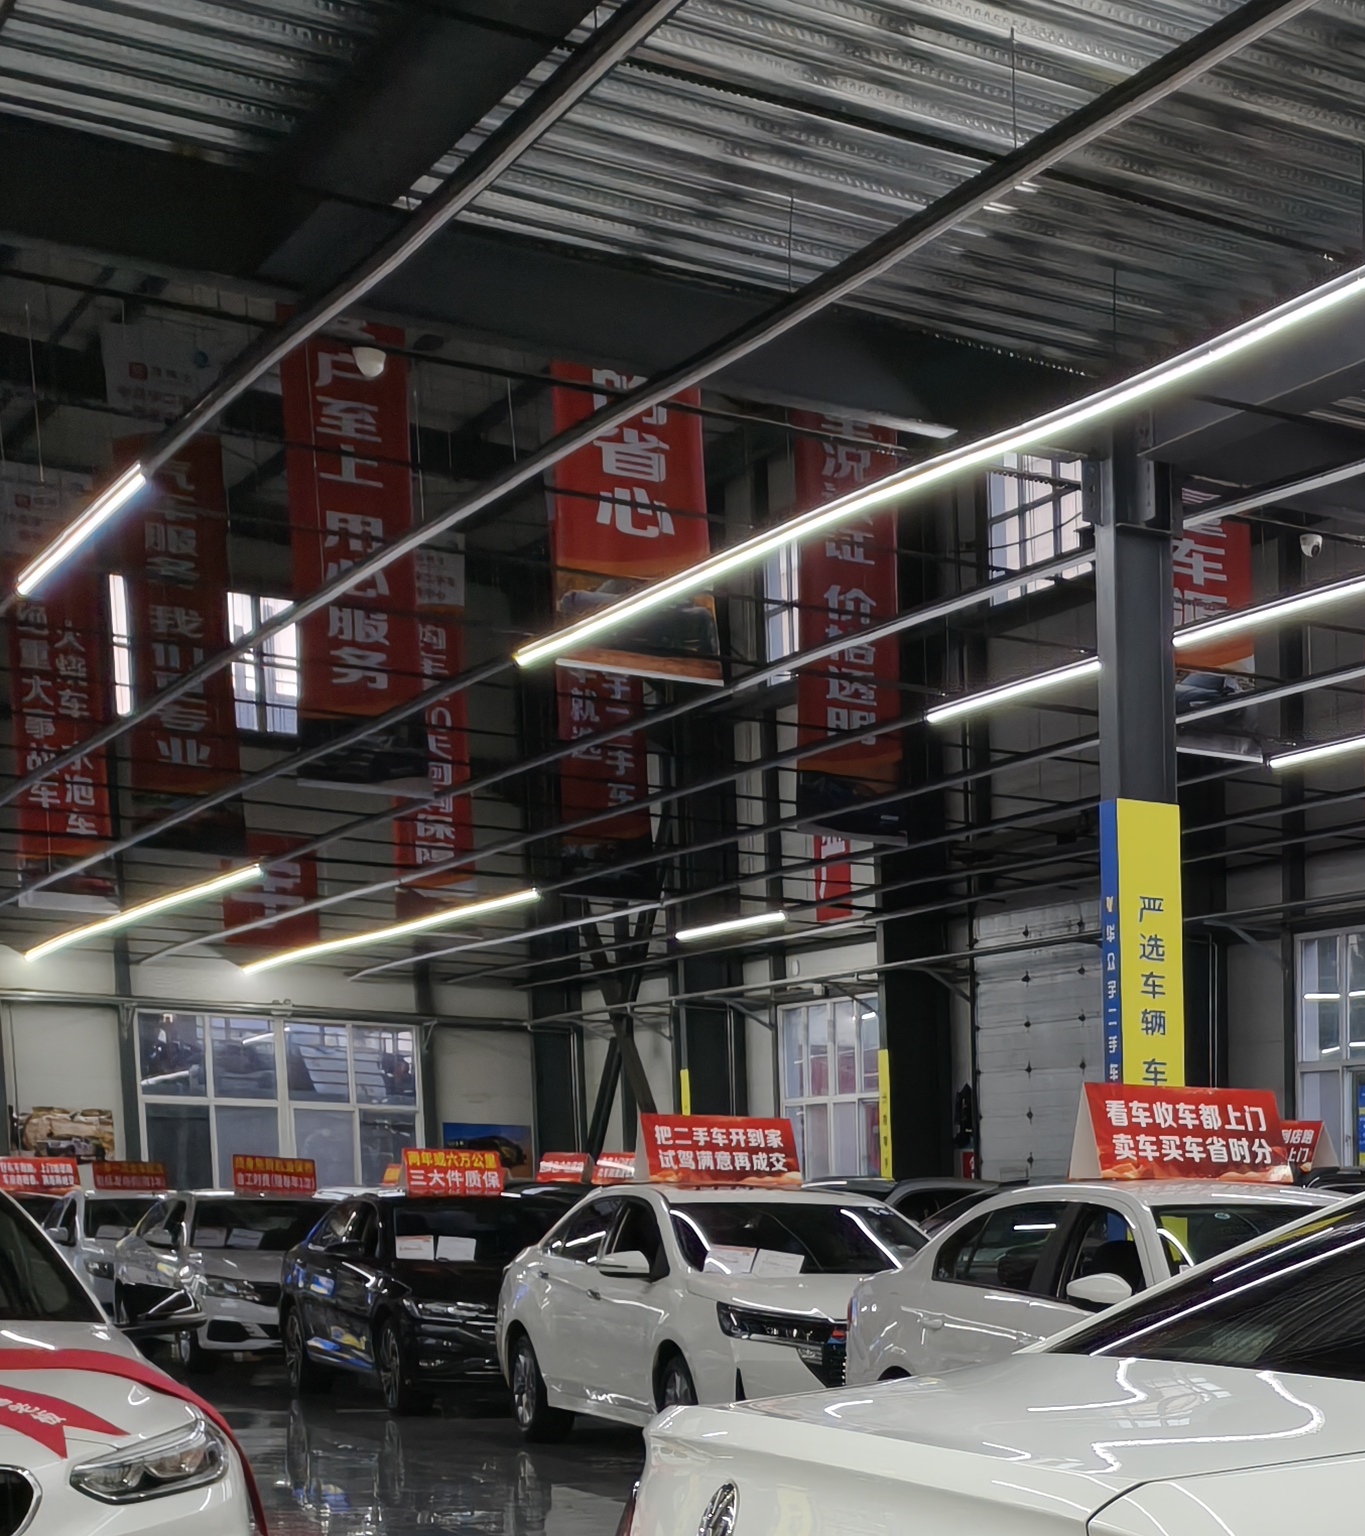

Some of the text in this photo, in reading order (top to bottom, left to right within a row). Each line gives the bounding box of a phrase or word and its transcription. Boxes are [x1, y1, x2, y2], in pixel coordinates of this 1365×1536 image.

[1138, 895, 1167, 1037] 严选车辆
[1105, 1099, 1267, 1132] 看车收车都上门
[654, 1124, 784, 1148] 把二手车开到家
[1113, 1132, 1272, 1165] 卖车买车省时分
[658, 1149, 788, 1172] 试驾满意再成交
[409, 1169, 500, 1189] 三大件质保
